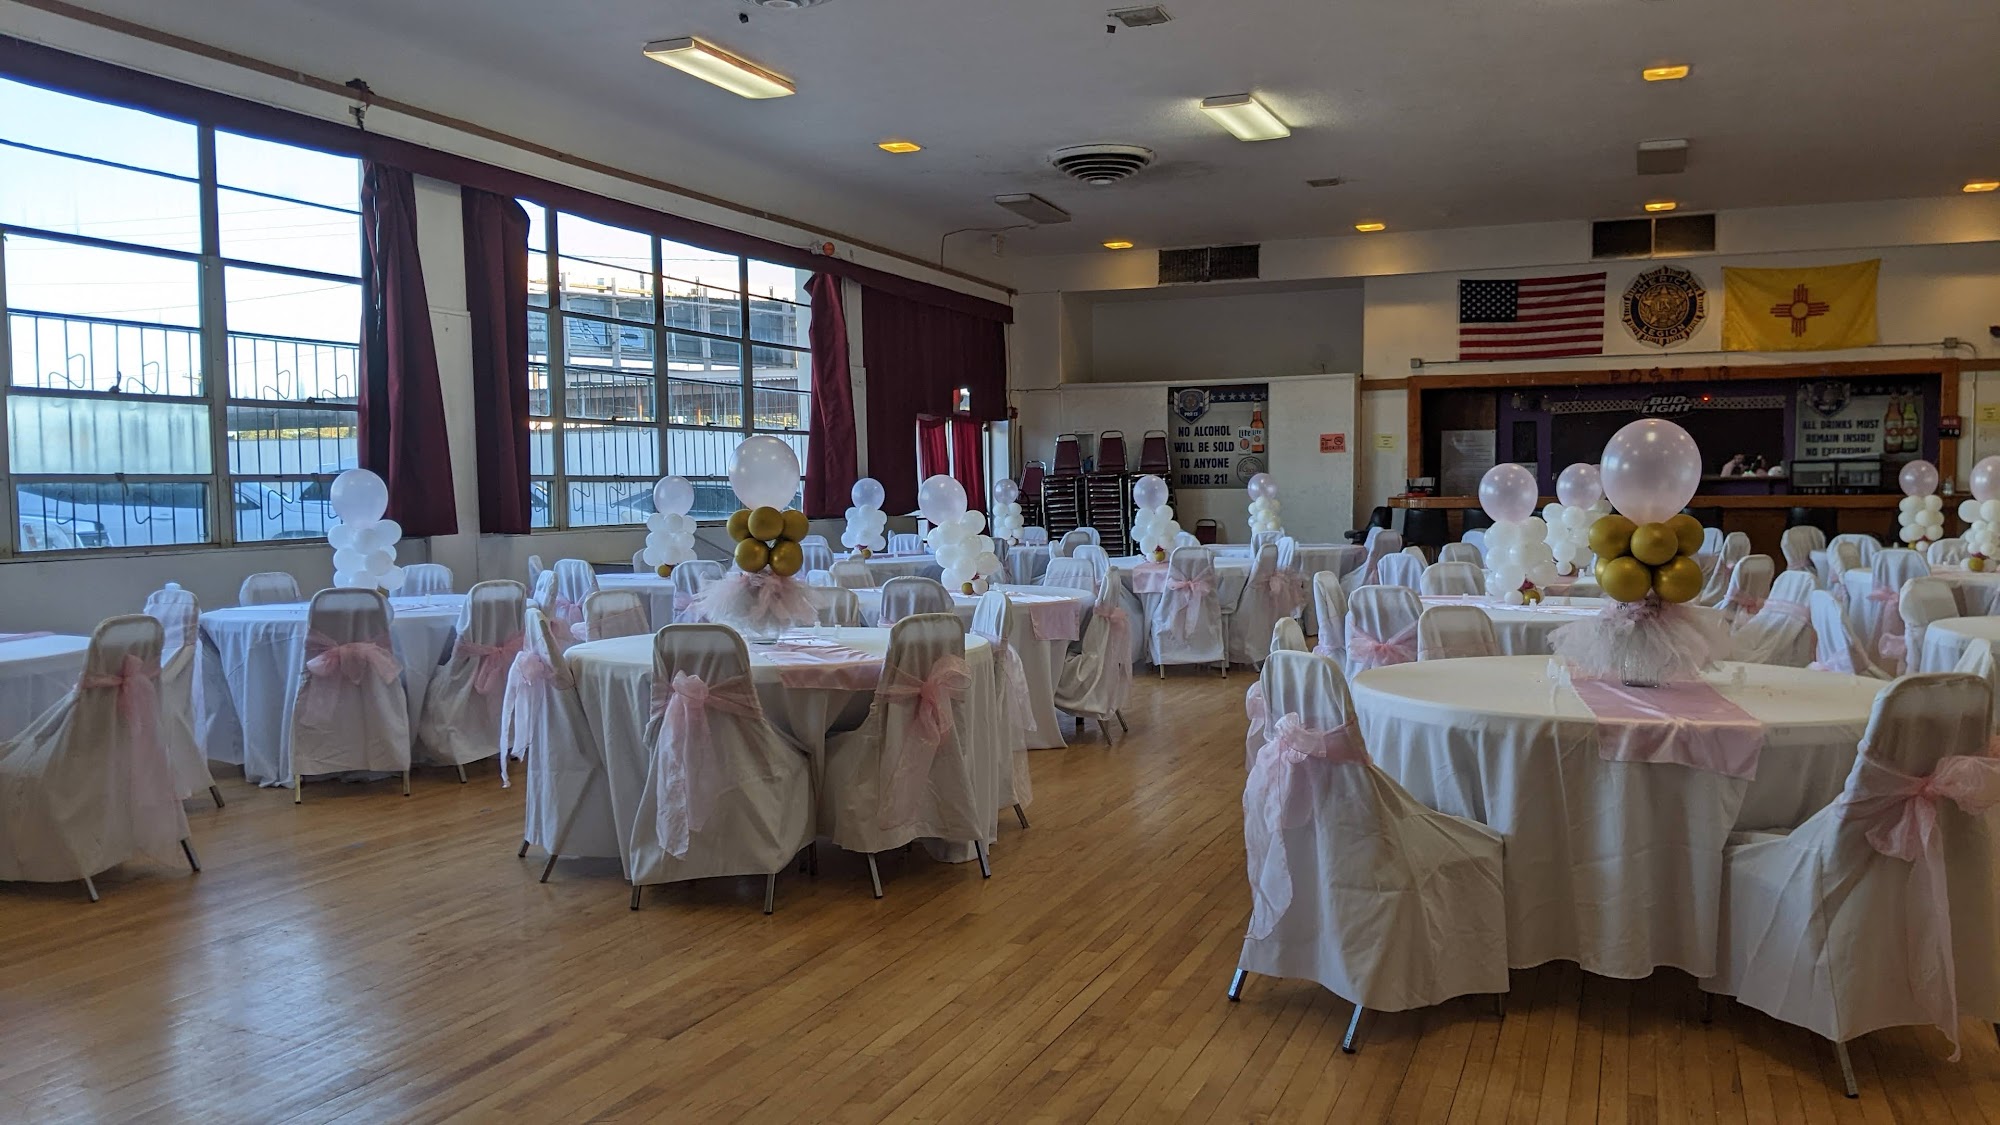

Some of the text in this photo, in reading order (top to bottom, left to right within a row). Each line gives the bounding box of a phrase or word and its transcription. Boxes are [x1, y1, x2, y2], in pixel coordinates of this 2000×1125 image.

[1634, 276, 1694, 300] AMERICAN
[1641, 323, 1686, 337] LEGION
[1649, 395, 1688, 405] BUD
[1641, 403, 1693, 414] LIGHT
[1802, 419, 1880, 429] ALL DRINKS MUST
[1178, 425, 1231, 437] NO ALCOHOL
[1238, 429, 1251, 438] Lite
[1806, 433, 1875, 443] REMAIN INSIDE!
[1174, 441, 1234, 453] WILL BE SOLD
[1805, 448, 1818, 456] NO
[1180, 458, 1190, 469] TO
[1193, 457, 1230, 469] ANYONE
[1180, 473, 1228, 485] UNDER 21!
